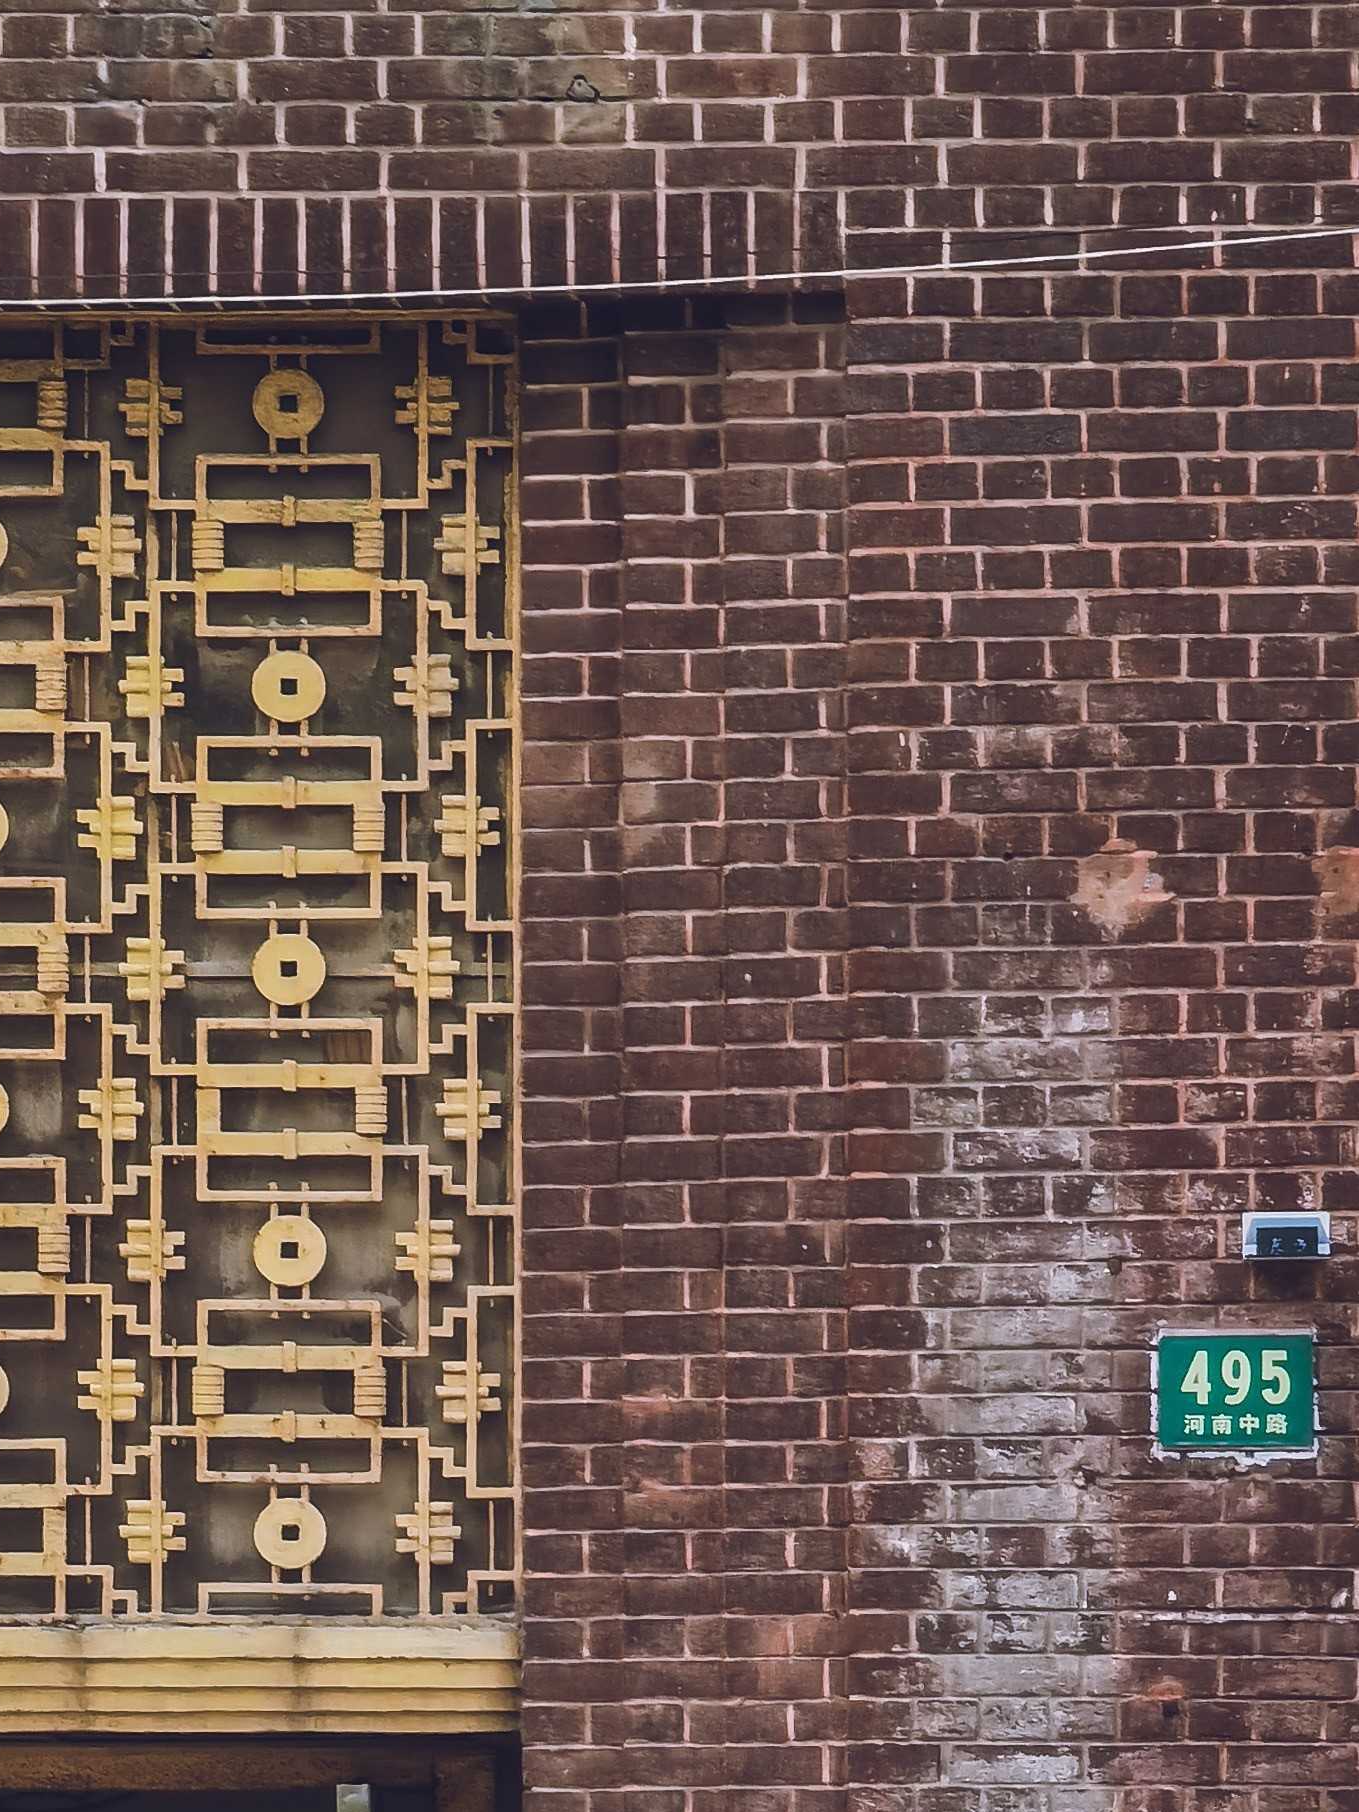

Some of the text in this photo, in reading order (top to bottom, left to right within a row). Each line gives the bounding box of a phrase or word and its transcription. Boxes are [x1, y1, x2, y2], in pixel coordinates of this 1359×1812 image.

[1181, 1350, 1291, 1405] 495
[1183, 1413, 1288, 1435] 河南中路
